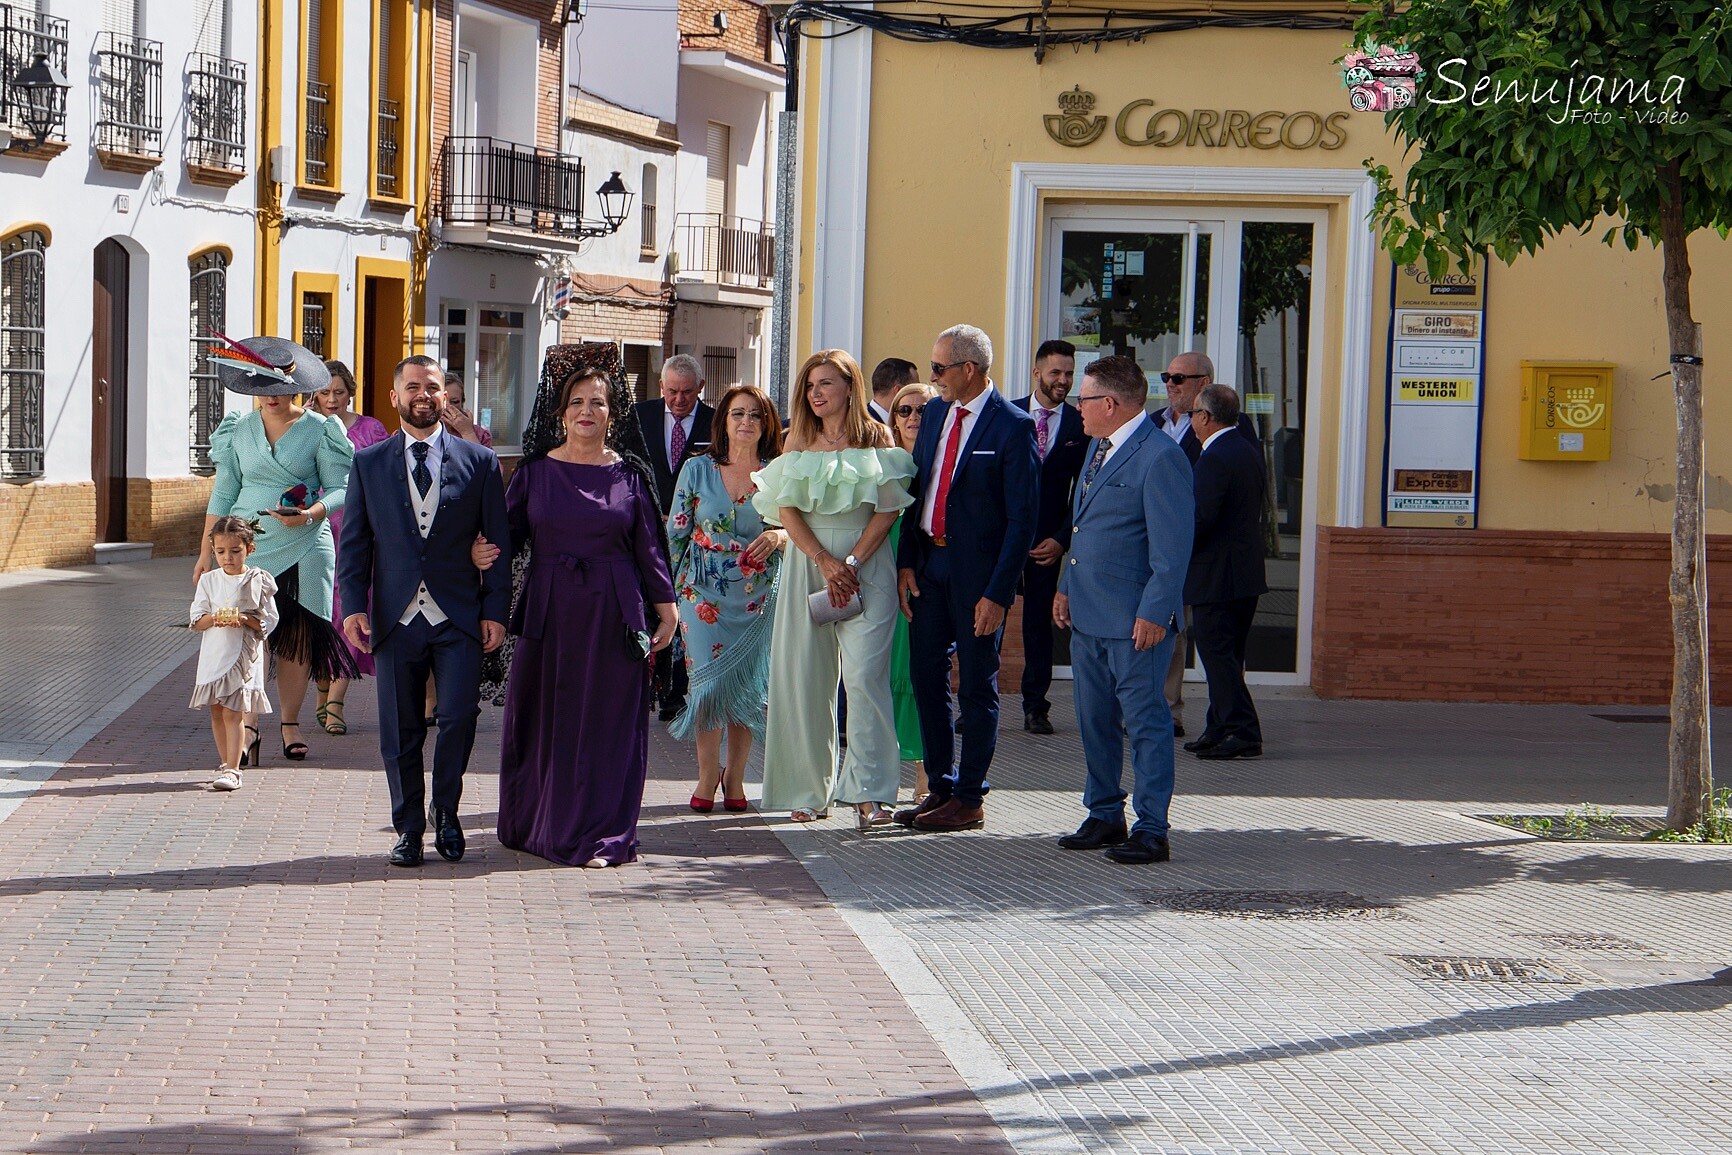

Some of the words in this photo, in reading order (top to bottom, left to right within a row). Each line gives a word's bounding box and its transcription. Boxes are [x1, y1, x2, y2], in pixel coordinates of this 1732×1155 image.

[1115, 98, 1350, 150] CORREOS
[1424, 316, 1452, 327] GIRO
[1431, 326, 1438, 334] al
[1439, 327, 1468, 335] instante
[1401, 381, 1457, 389] WESTERN
[1418, 389, 1457, 398] UNION
[1406, 476, 1458, 490] Express
